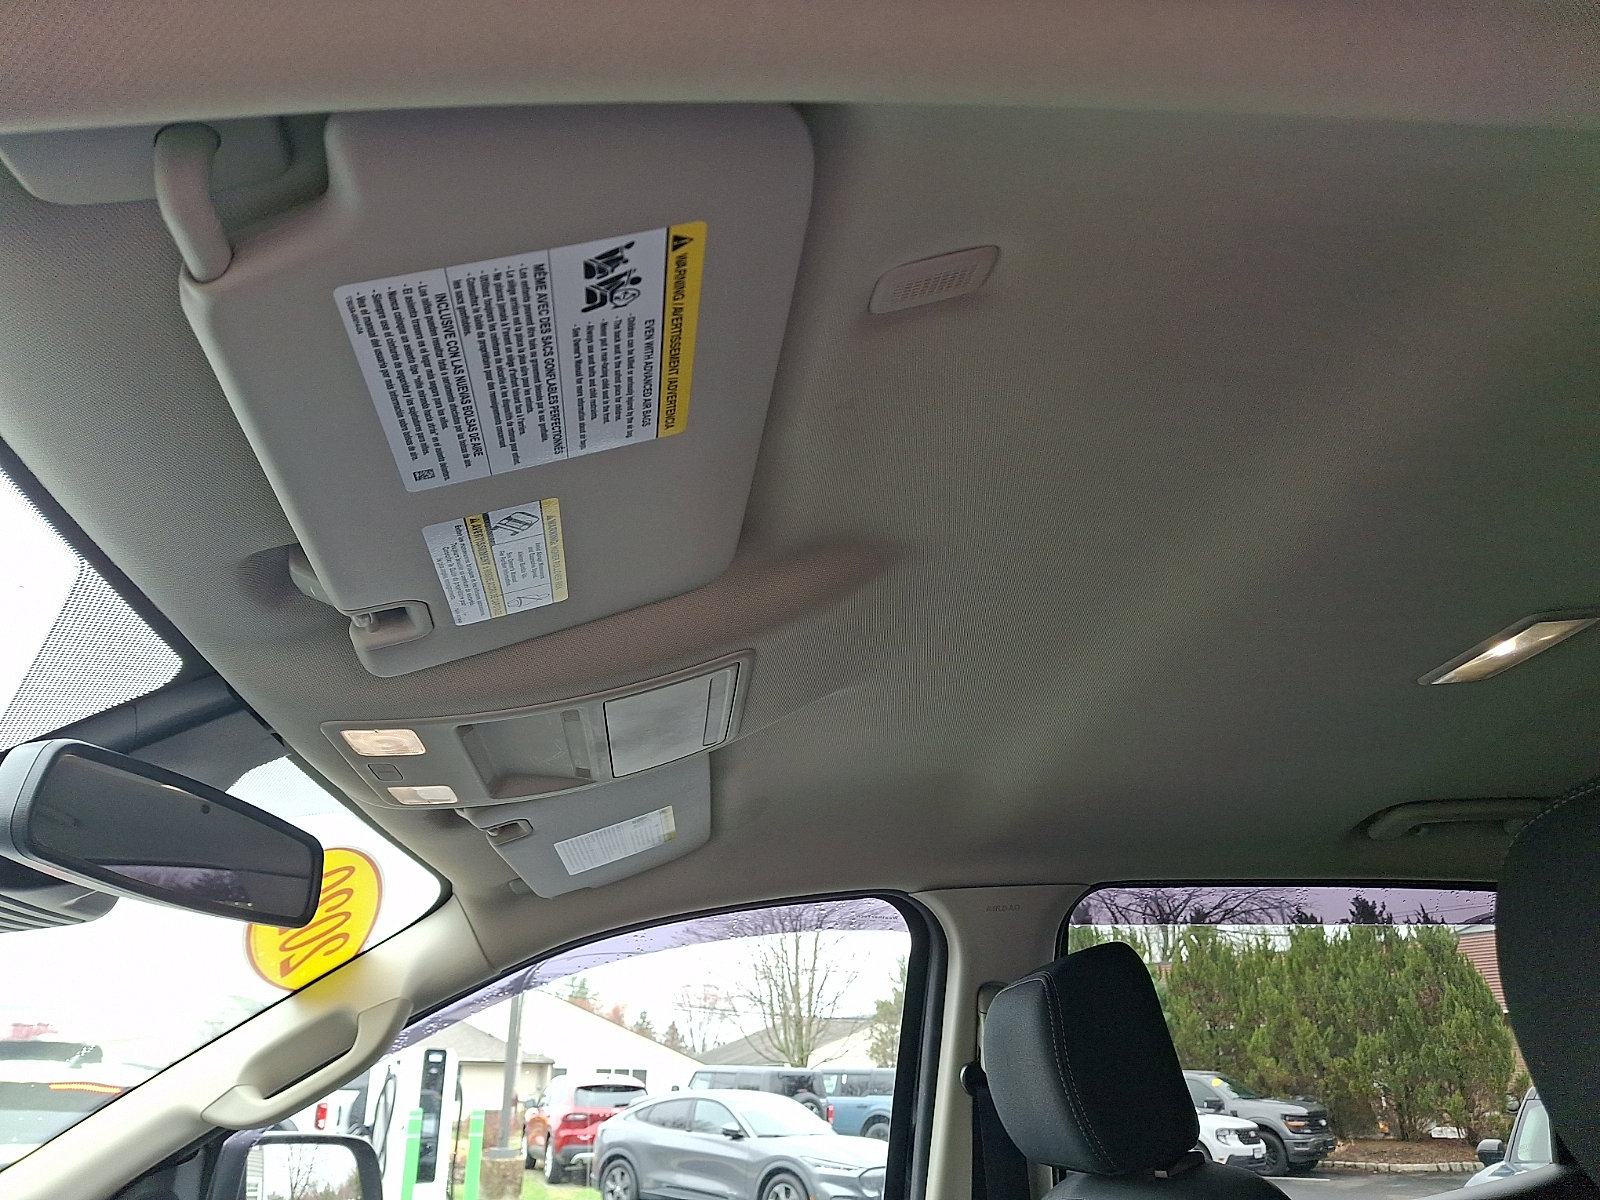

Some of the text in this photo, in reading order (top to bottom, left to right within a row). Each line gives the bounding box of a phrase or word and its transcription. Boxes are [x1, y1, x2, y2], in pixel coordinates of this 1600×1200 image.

[673, 253, 687, 301] WARNING
[434, 293, 483, 457] INCLUSIVE CON LAS NUEVAS BOLSAS DE AIRE
[533, 263, 565, 454] MÊME AVEC DES SACS GONFLABLES PERFECTIONNÉS
[641, 319, 655, 427] EVEN WITH ADVANCED AIR BAGS
[668, 307, 683, 375] AVERTISSEMENT
[665, 380, 678, 429] ADVERTENCIA
